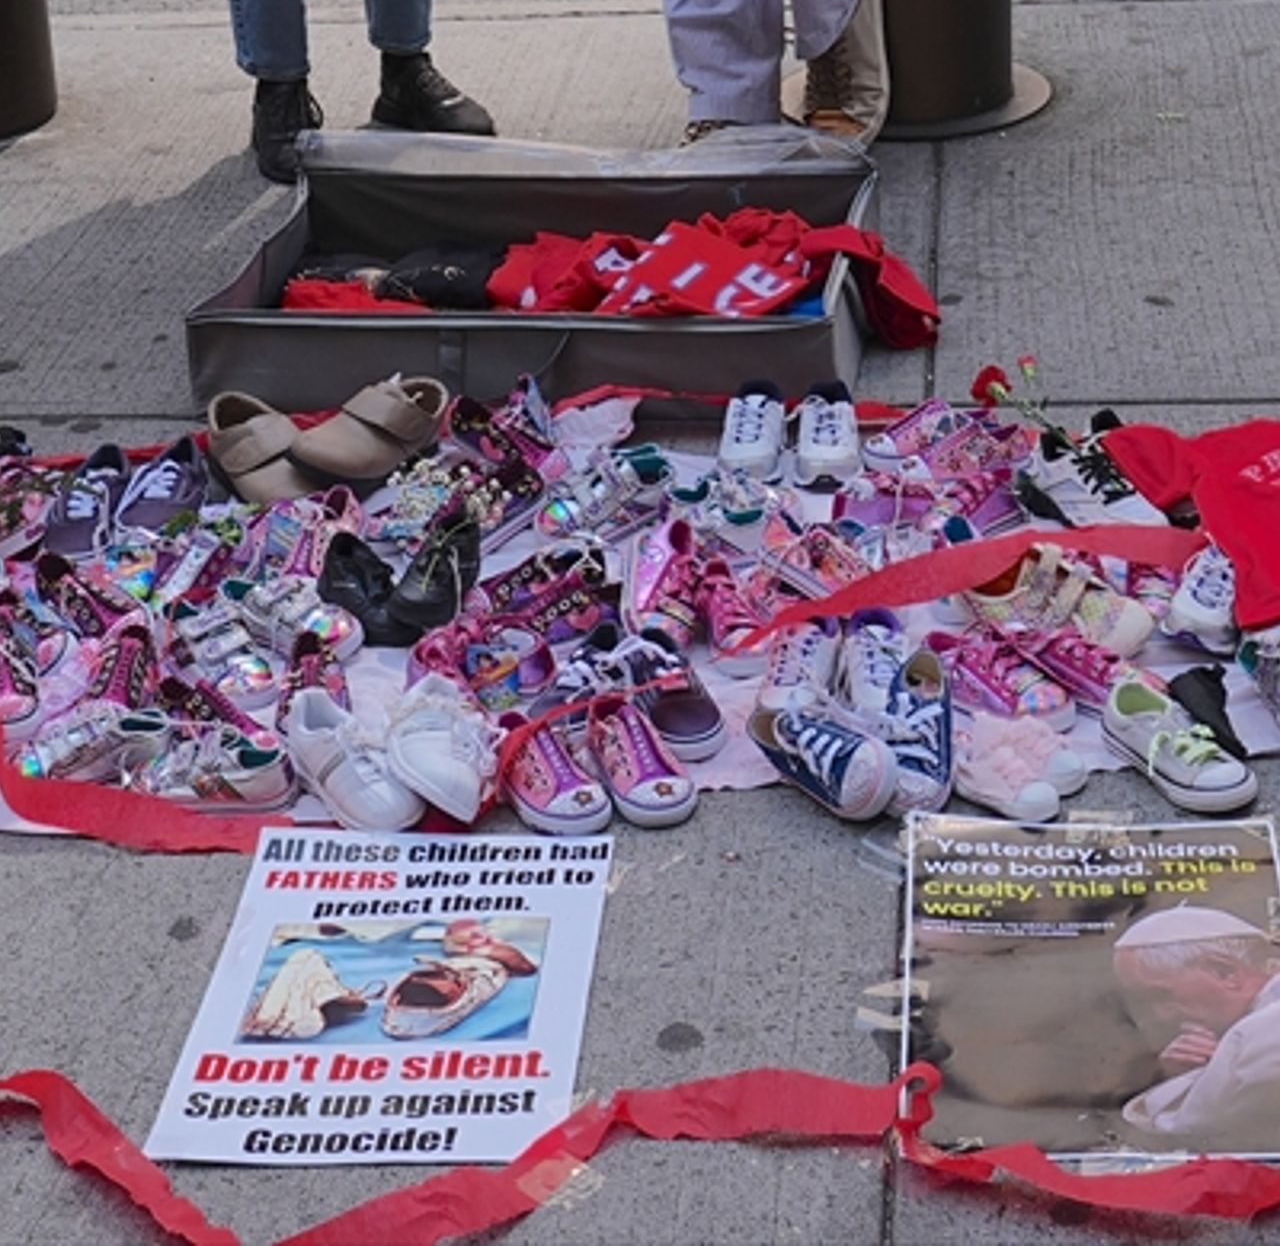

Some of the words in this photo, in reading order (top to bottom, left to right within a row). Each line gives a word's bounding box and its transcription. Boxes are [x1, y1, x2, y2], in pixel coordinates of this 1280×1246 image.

[262, 838, 305, 863] All
[312, 839, 401, 863] these
[408, 842, 542, 864] children
[549, 841, 610, 861] had
[1108, 841, 1239, 858] children
[265, 870, 399, 890] FATHERS
[405, 870, 471, 889] who
[479, 867, 556, 886] tried
[562, 867, 595, 885] to
[923, 859, 1001, 877] were
[1009, 860, 1153, 879] bombed.
[1159, 858, 1225, 875] This
[1231, 858, 1257, 874] is
[1050, 880, 1115, 899] This
[1121, 877, 1147, 896] is
[1154, 876, 1210, 894] not
[313, 895, 434, 920] protect
[440, 893, 532, 913] them.
[194, 1053, 321, 1083] Don't
[328, 1053, 390, 1083] be
[400, 1050, 552, 1081] silent.
[184, 1091, 312, 1120] Speak
[318, 1093, 373, 1119] up
[380, 1089, 537, 1118] against
[243, 1127, 458, 1155] Genocide!
